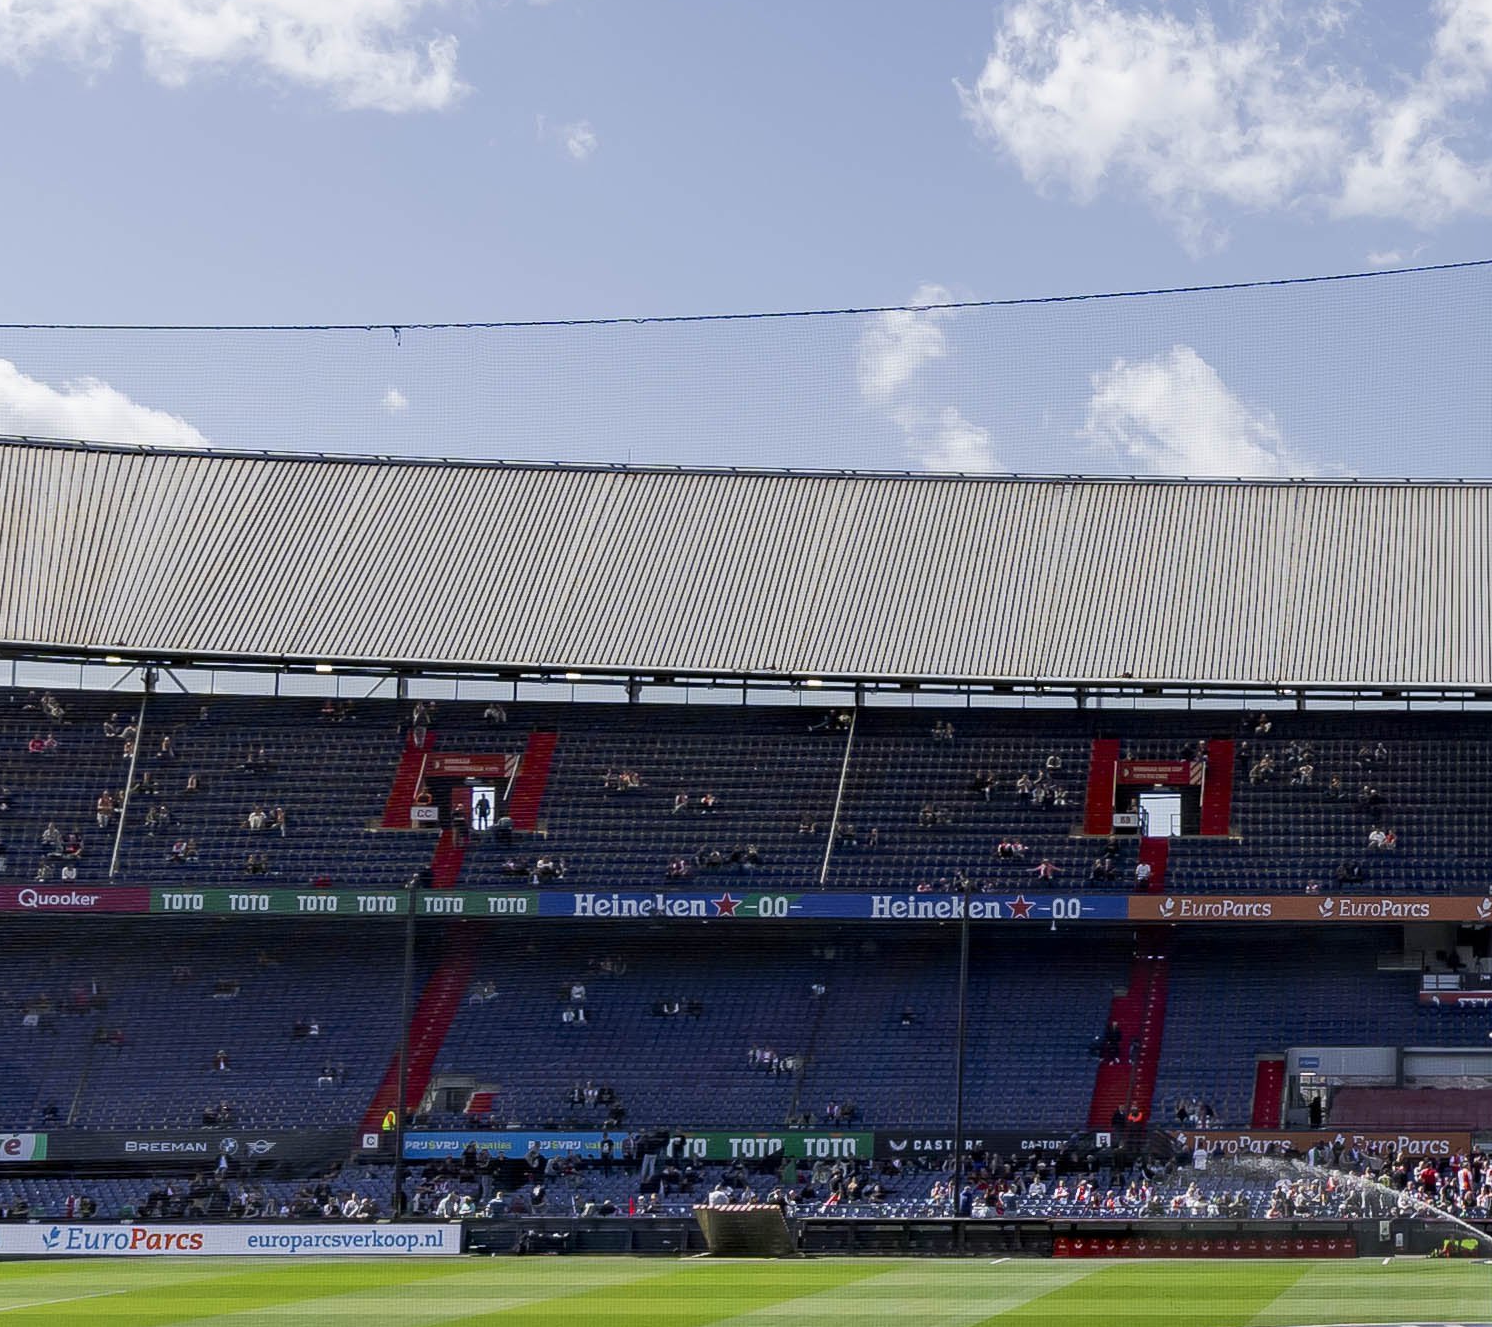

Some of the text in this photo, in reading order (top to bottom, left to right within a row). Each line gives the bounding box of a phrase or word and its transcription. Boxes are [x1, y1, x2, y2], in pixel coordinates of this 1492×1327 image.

[18, 888, 99, 908] Quooker
[162, 893, 204, 911] TOTO
[228, 894, 269, 912] TOTO
[297, 895, 338, 912] TOTO
[356, 896, 397, 913] TOTO
[424, 896, 464, 913] TOTO
[487, 897, 527, 914] TOTO
[573, 893, 707, 918] Heineken
[871, 895, 1002, 919] Heineken
[1179, 899, 1272, 918] EuroParcs
[1339, 899, 1430, 918] EuroParcs
[124, 1140, 207, 1152] BREEMAN
[728, 1138, 783, 1159] TOTO
[803, 1138, 857, 1159] TOTO
[65, 1227, 203, 1251] EuroParcs
[247, 1229, 444, 1254] europarcsverkoop.nl
